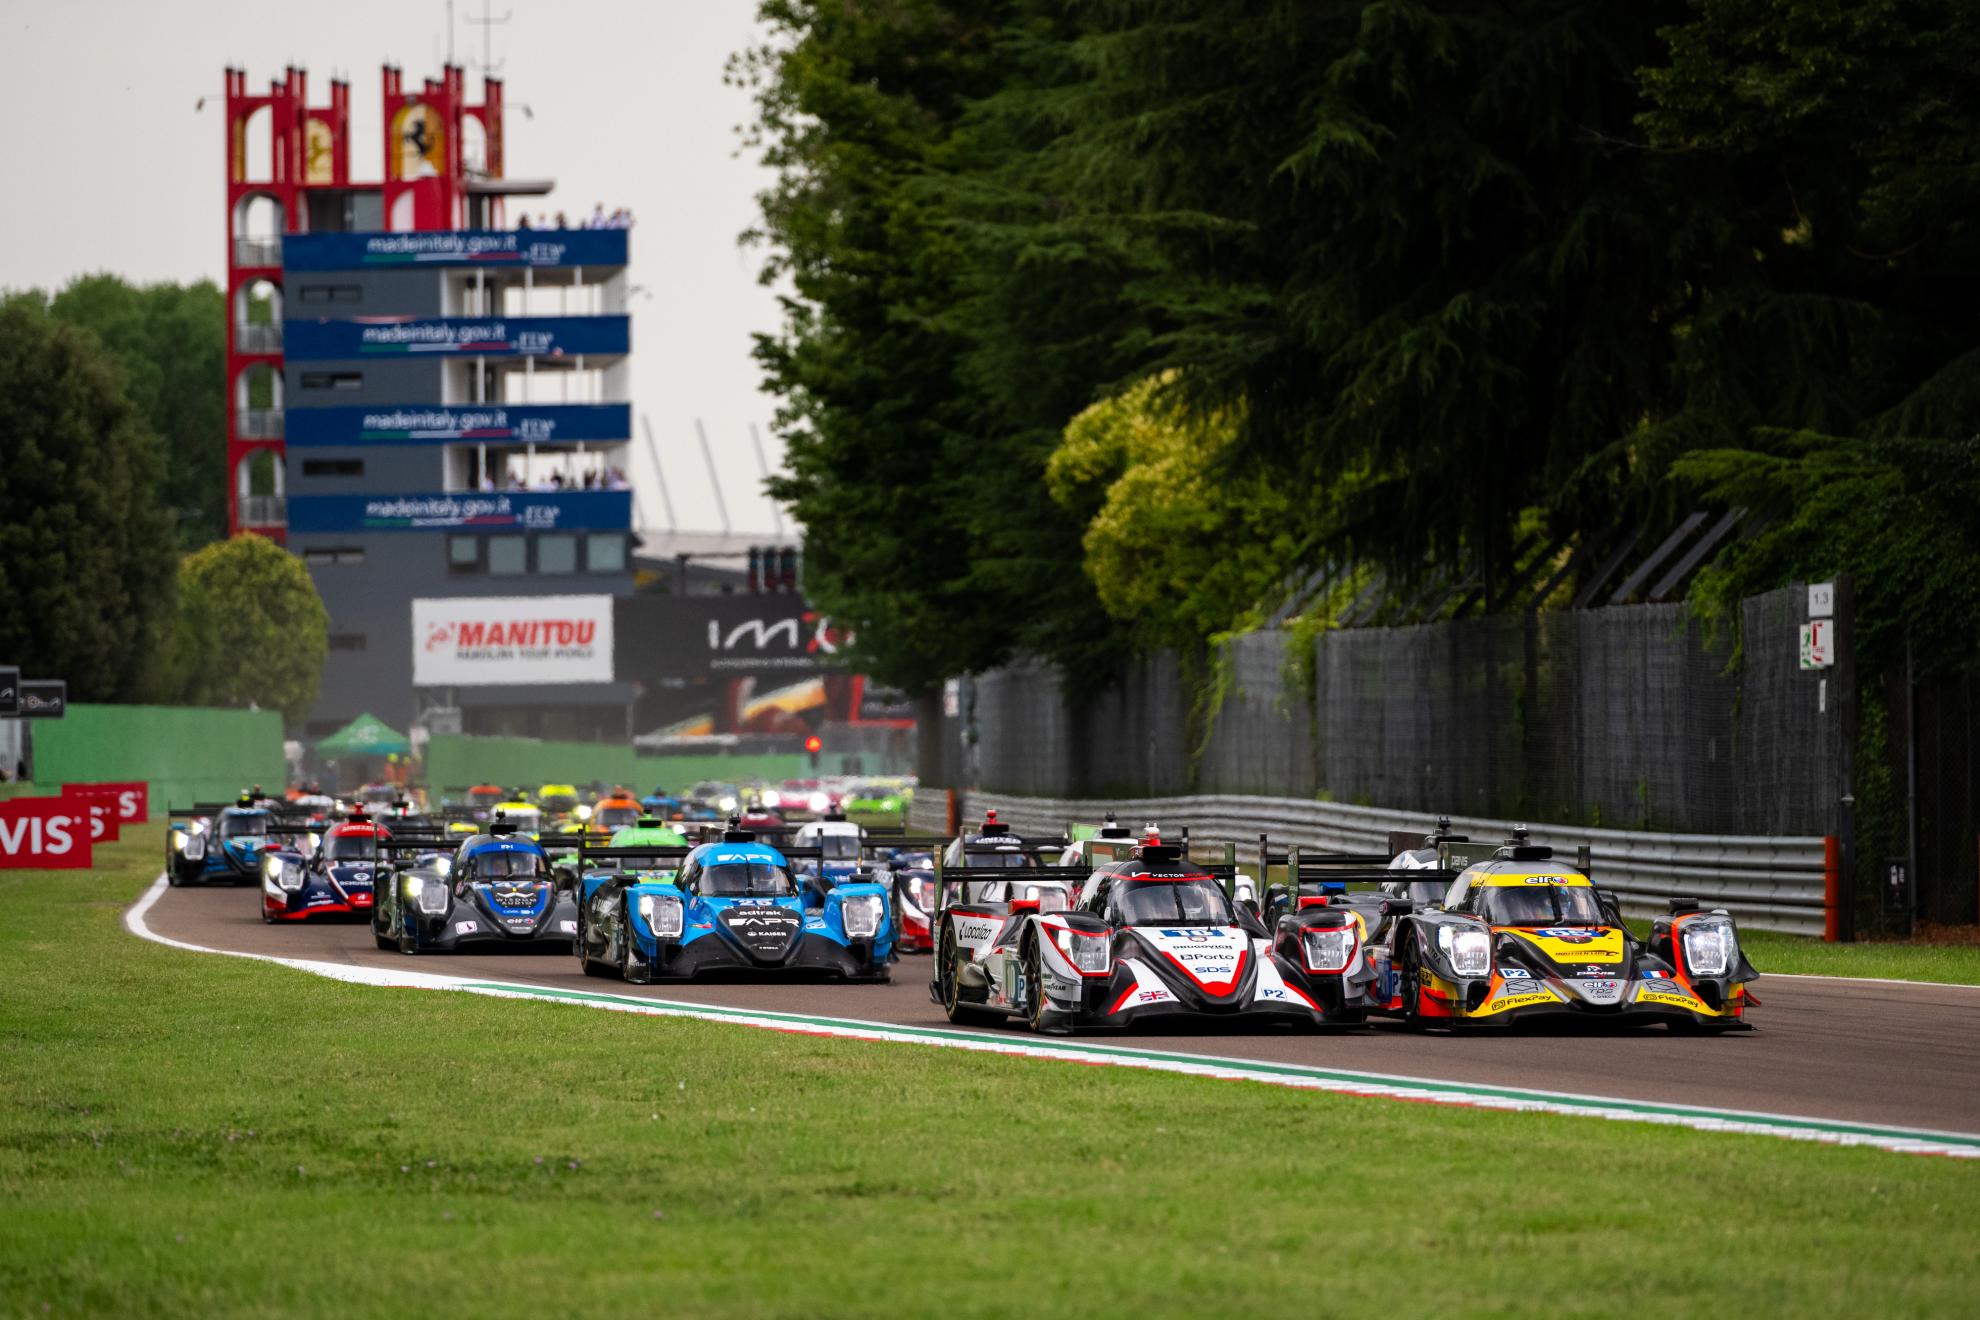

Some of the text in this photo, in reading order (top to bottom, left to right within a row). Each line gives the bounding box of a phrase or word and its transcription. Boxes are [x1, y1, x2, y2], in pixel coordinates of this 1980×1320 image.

[367, 233, 517, 253] madeinitaly.gov.it
[362, 323, 506, 343] madeinitaly.gov.it
[363, 411, 508, 431] madeinitaly.gov.it
[366, 497, 511, 519] madeinitaly.gov.it
[458, 620, 596, 647] MANITOU
[1525, 876, 1553, 884] elf
[965, 924, 992, 940] Localiza
[1504, 969, 1528, 977] P2
[1264, 988, 1285, 999] P2
[1507, 994, 1552, 1005] FlexPay
[1658, 995, 1698, 1008] FlexPay
